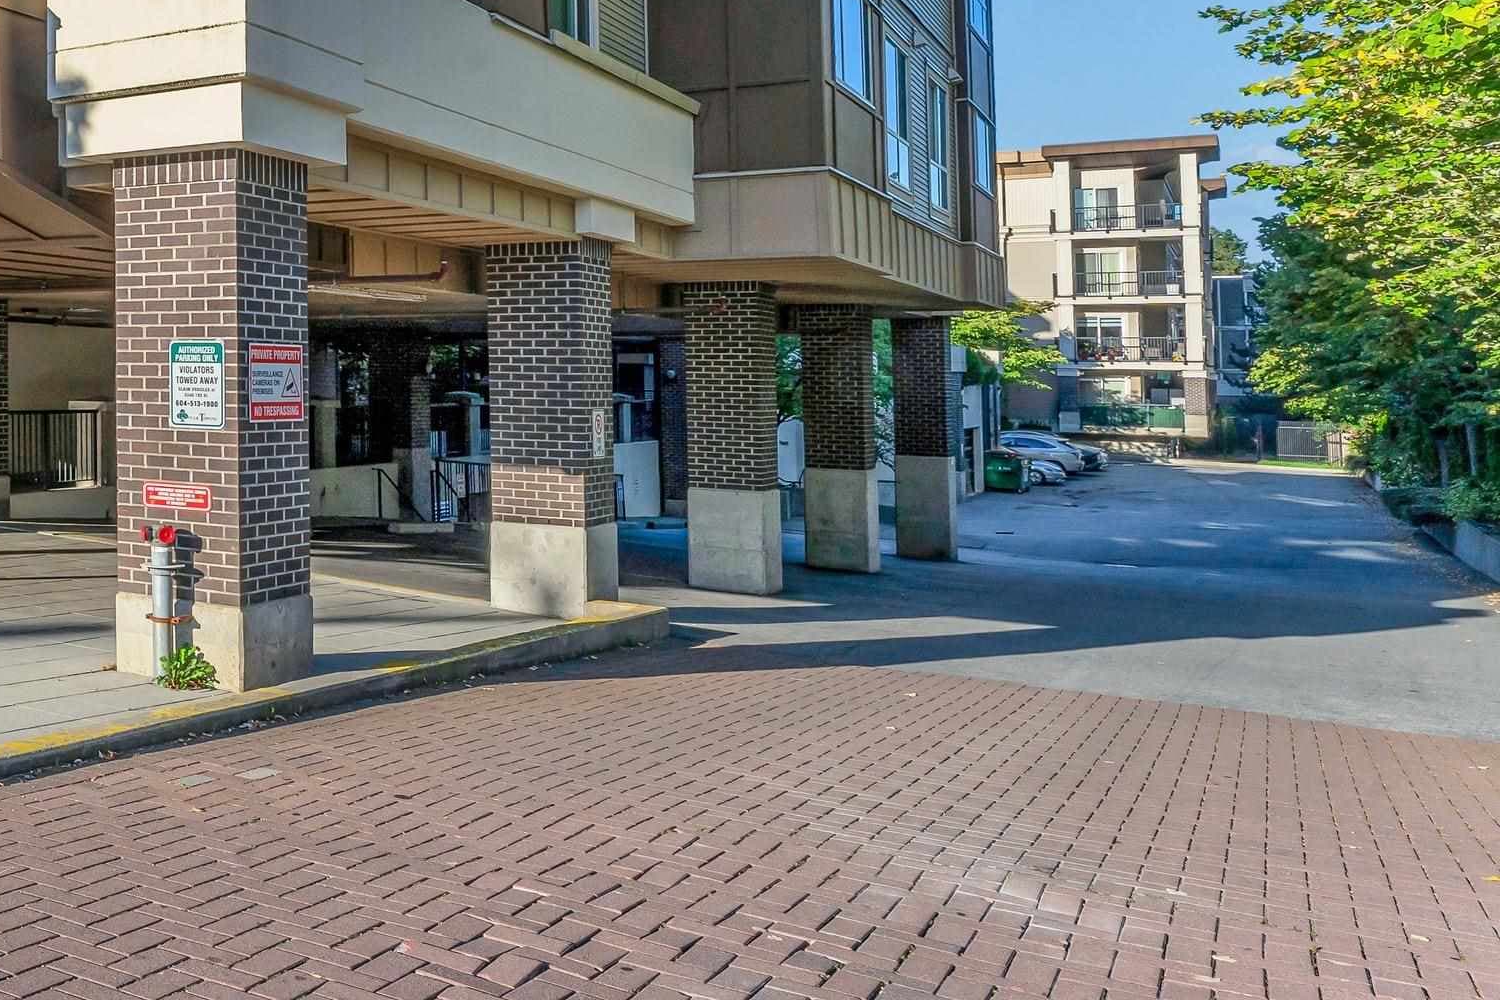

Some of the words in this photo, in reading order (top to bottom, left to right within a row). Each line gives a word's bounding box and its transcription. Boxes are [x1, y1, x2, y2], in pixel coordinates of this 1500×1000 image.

[175, 354, 200, 362] PARKING
[252, 349, 272, 360] PRIVATE
[274, 350, 300, 361] PROPERTY
[179, 366, 214, 374] VIOLATORS
[176, 376, 198, 384] TOWED
[200, 376, 219, 385] AWAY
[254, 405, 263, 417] NO
[263, 405, 300, 417] TRESPASSING
